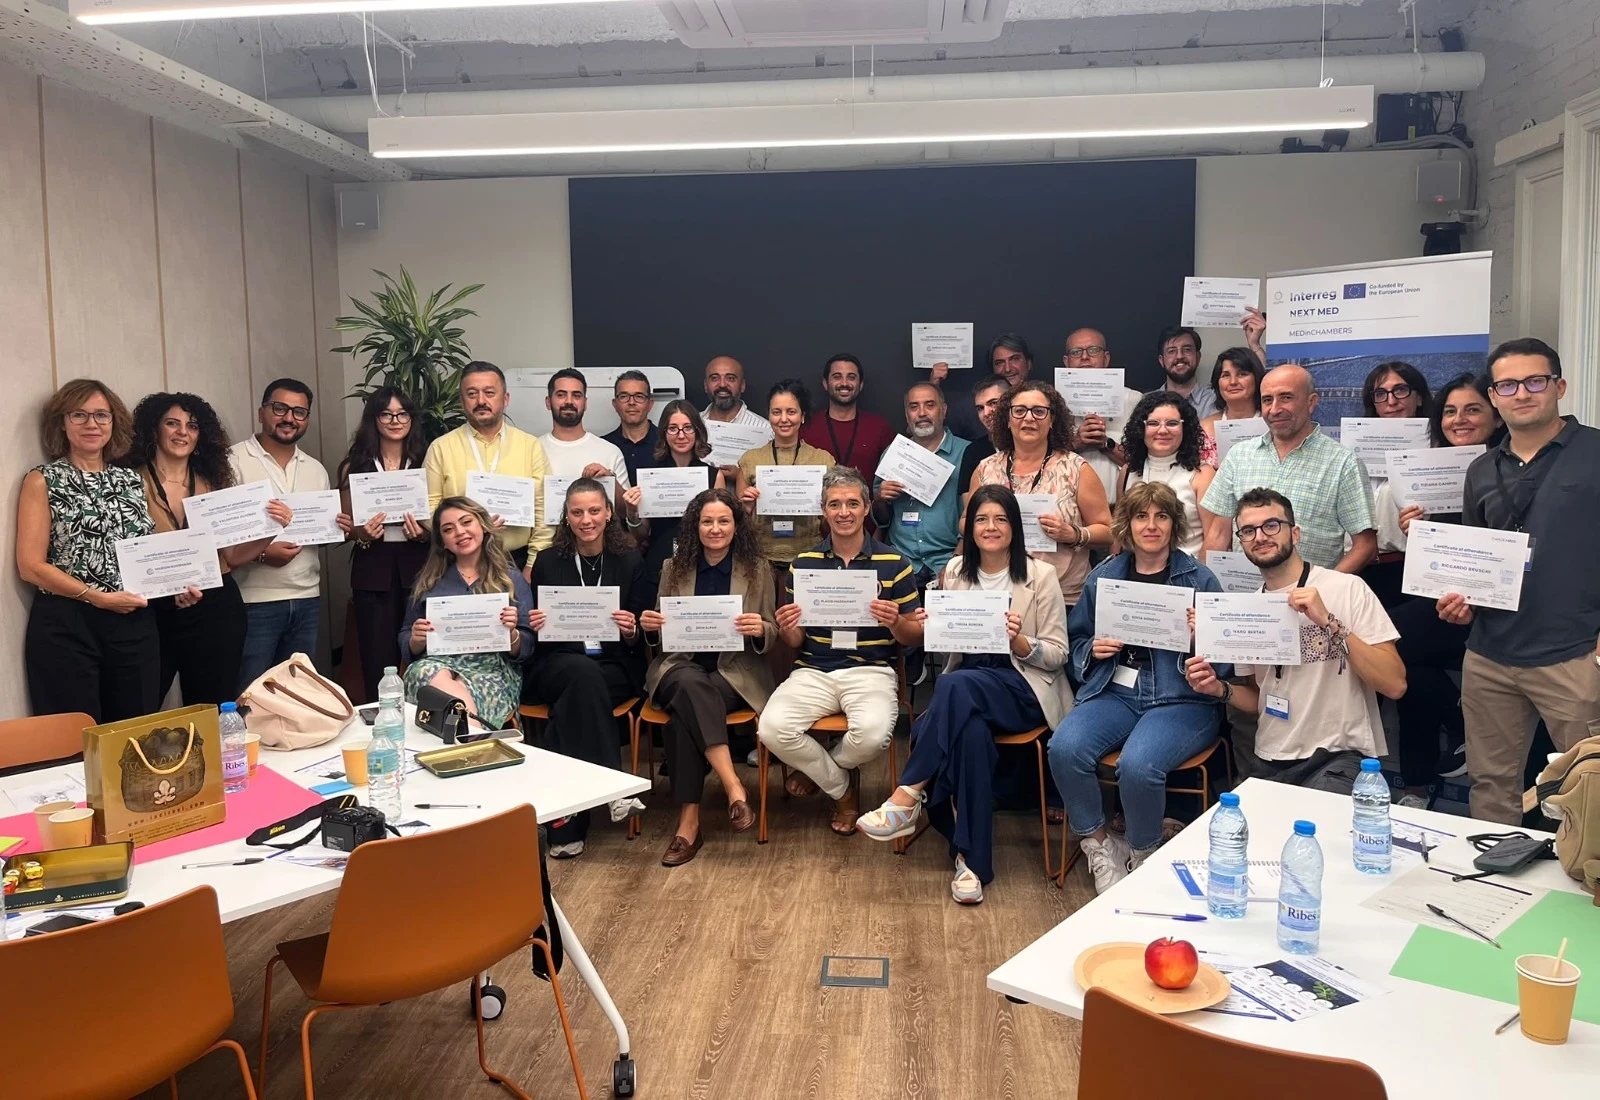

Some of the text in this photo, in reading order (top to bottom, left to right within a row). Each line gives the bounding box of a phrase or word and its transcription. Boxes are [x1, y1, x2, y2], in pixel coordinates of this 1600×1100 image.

[1290, 289, 1337, 302] Interreg
[1289, 306, 1339, 318] NEXT MED
[1289, 327, 1353, 337] MEDinCHAMBERS
[269, 825, 286, 835] Nikon
[1358, 834, 1384, 845] Ribes
[1288, 907, 1317, 920] Ribes
